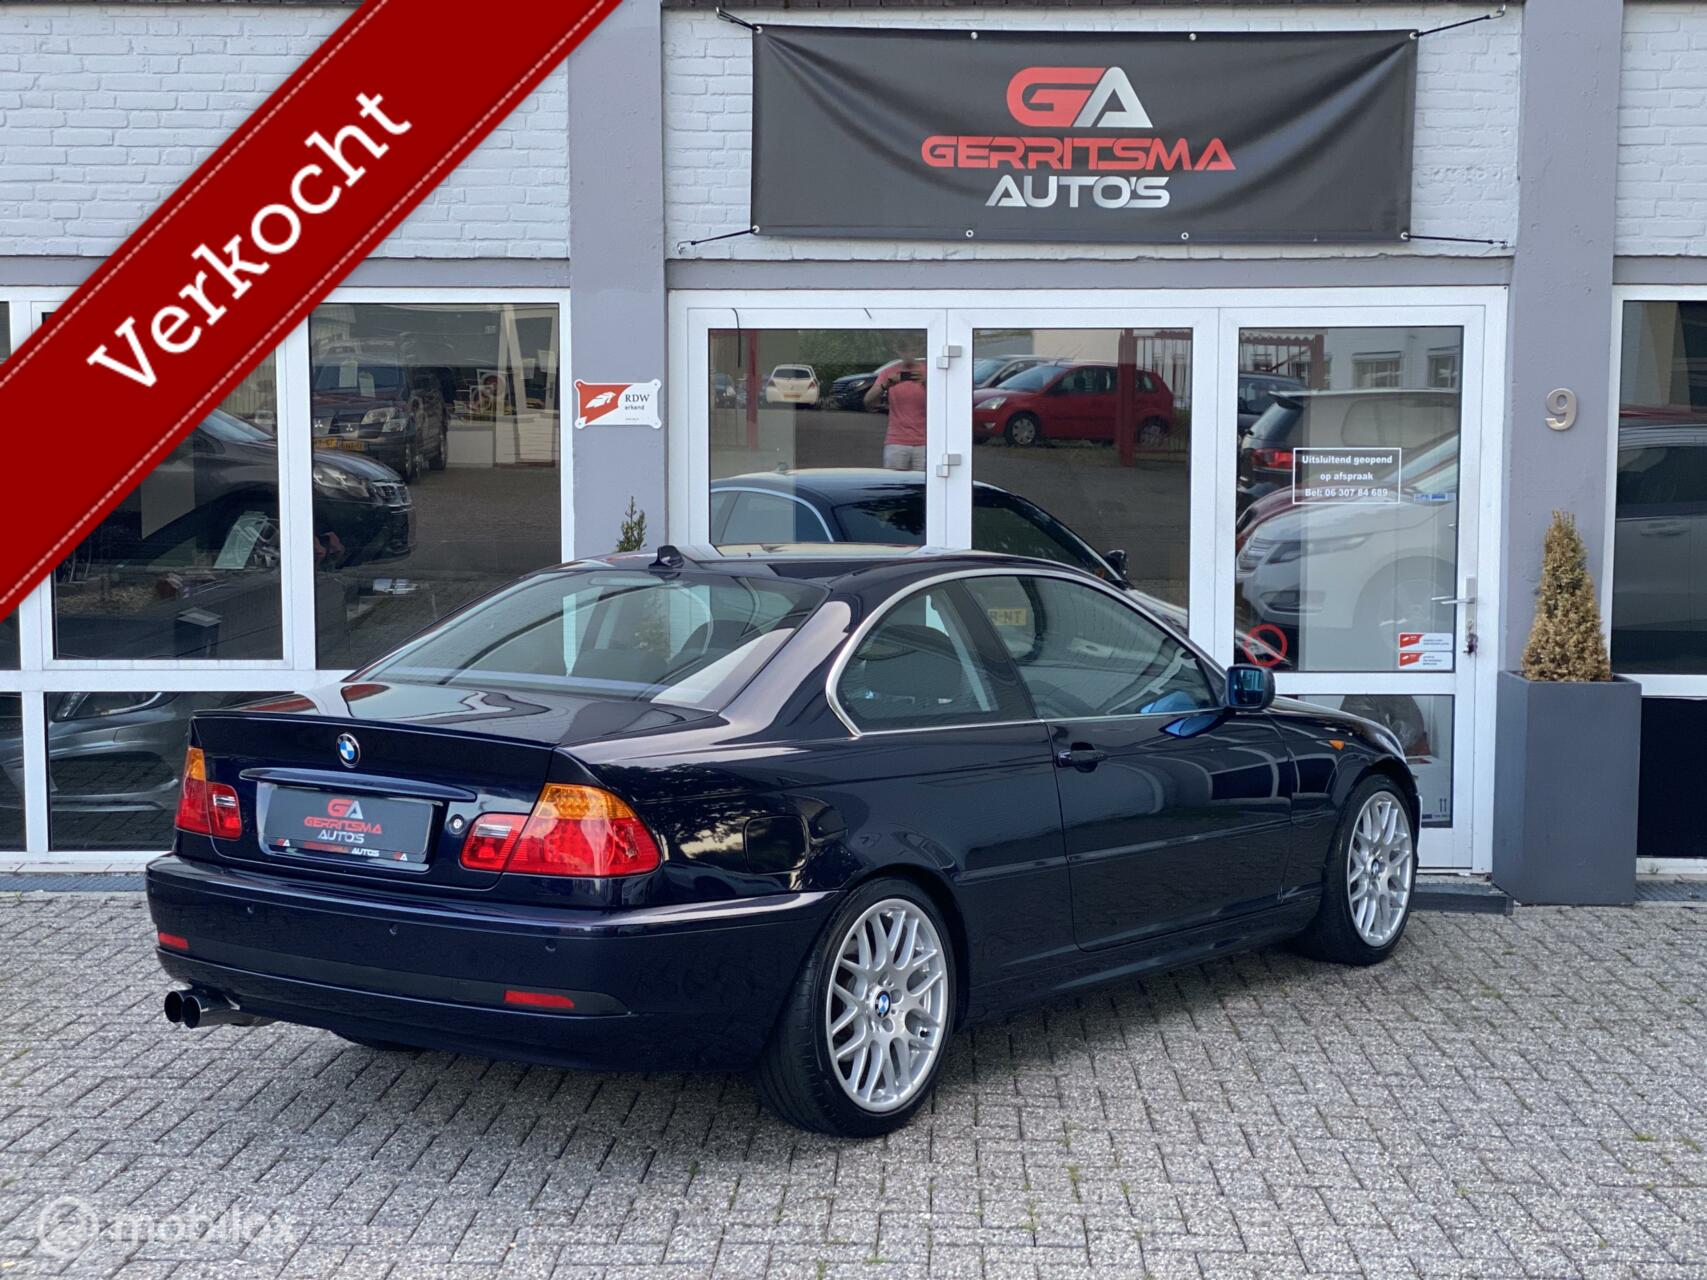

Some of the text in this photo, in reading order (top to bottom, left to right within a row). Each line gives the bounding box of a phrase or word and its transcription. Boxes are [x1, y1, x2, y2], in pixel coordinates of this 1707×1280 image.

[1006, 66, 1153, 128] GA
[921, 135, 1237, 171] GERRITSMA
[985, 174, 1170, 209] AUTO'S
[625, 394, 649, 402] RDW
[1544, 387, 1577, 431] 9
[1302, 455, 1393, 465] Uitsluitend geopend
[1320, 472, 1374, 482] op afspraak
[1305, 488, 1322, 497] Bel:
[1325, 488, 1336, 497] 06
[1339, 488, 1355, 497] 307
[1357, 488, 1369, 497] 84
[327, 798, 364, 820] GA
[304, 816, 382, 834] GERRITSMA
